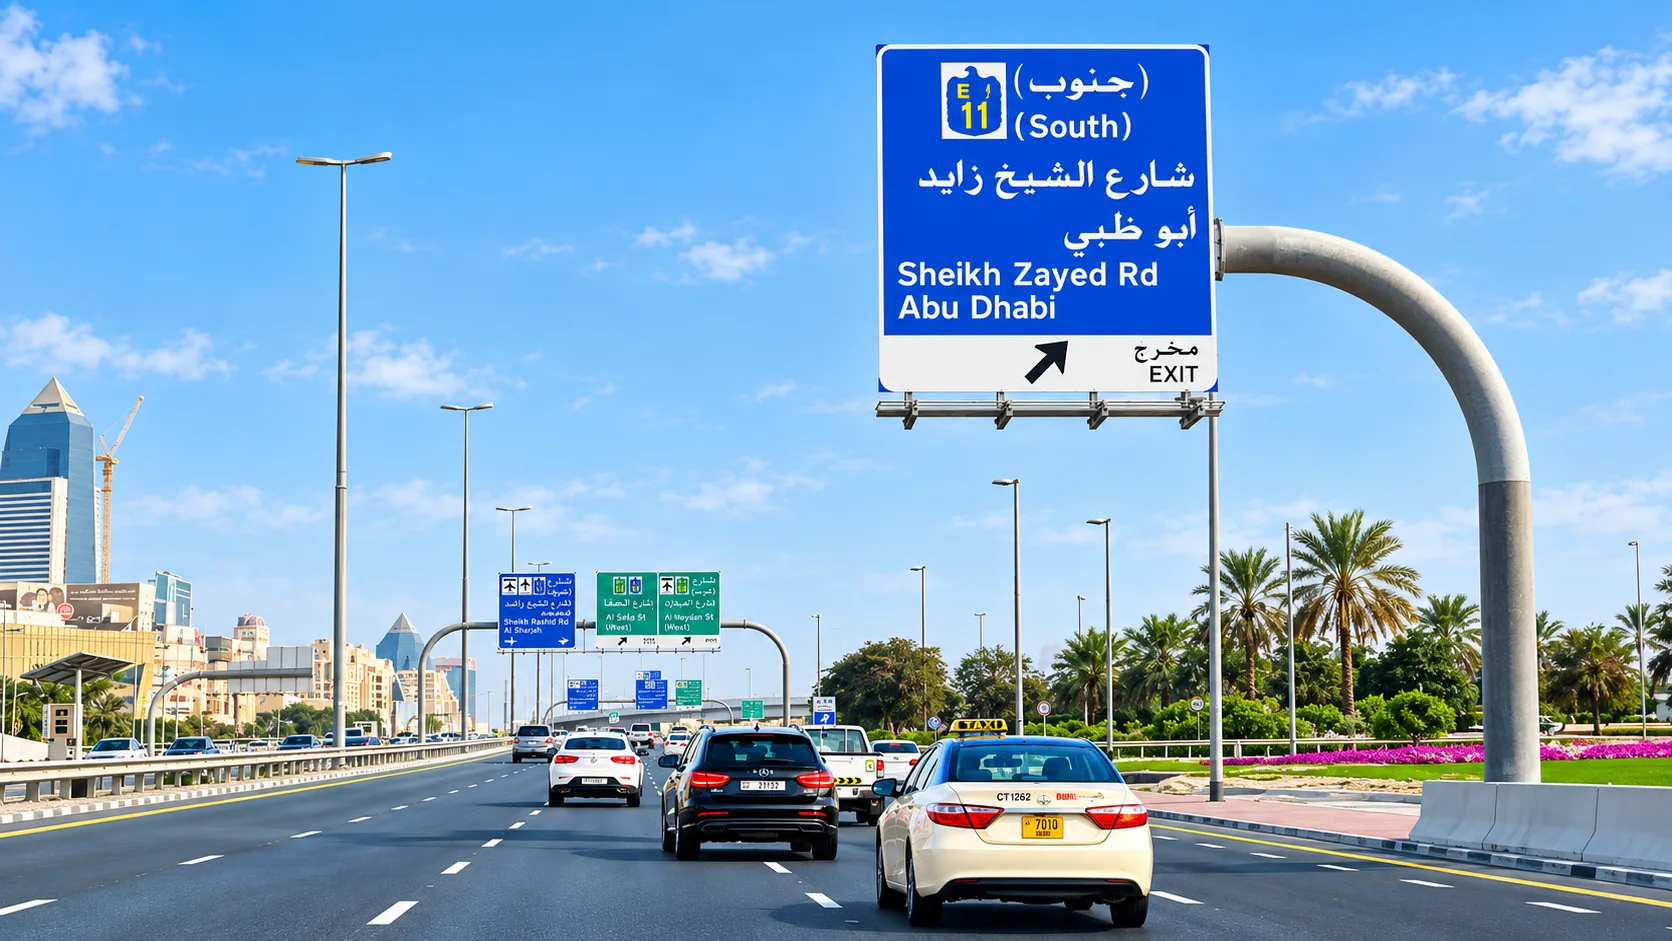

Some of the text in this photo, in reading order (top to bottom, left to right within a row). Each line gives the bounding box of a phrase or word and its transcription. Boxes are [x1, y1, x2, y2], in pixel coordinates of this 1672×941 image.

[957, 84, 970, 99] E
[1014, 63, 1149, 101] (جنوب)
[961, 101, 988, 129] 11
[1015, 111, 1132, 141] (South)
[918, 159, 1195, 200] شارع الشيخ زايد
[1063, 205, 1197, 258] أبو ظبي
[897, 261, 1158, 293] Sheikh Zayed Rd
[898, 294, 1056, 320] Abu Dhabi
[1134, 341, 1199, 364] مخرج
[1149, 365, 1199, 383] EXIT
[963, 720, 998, 730] TAXI
[1035, 818, 1058, 831] 7010
